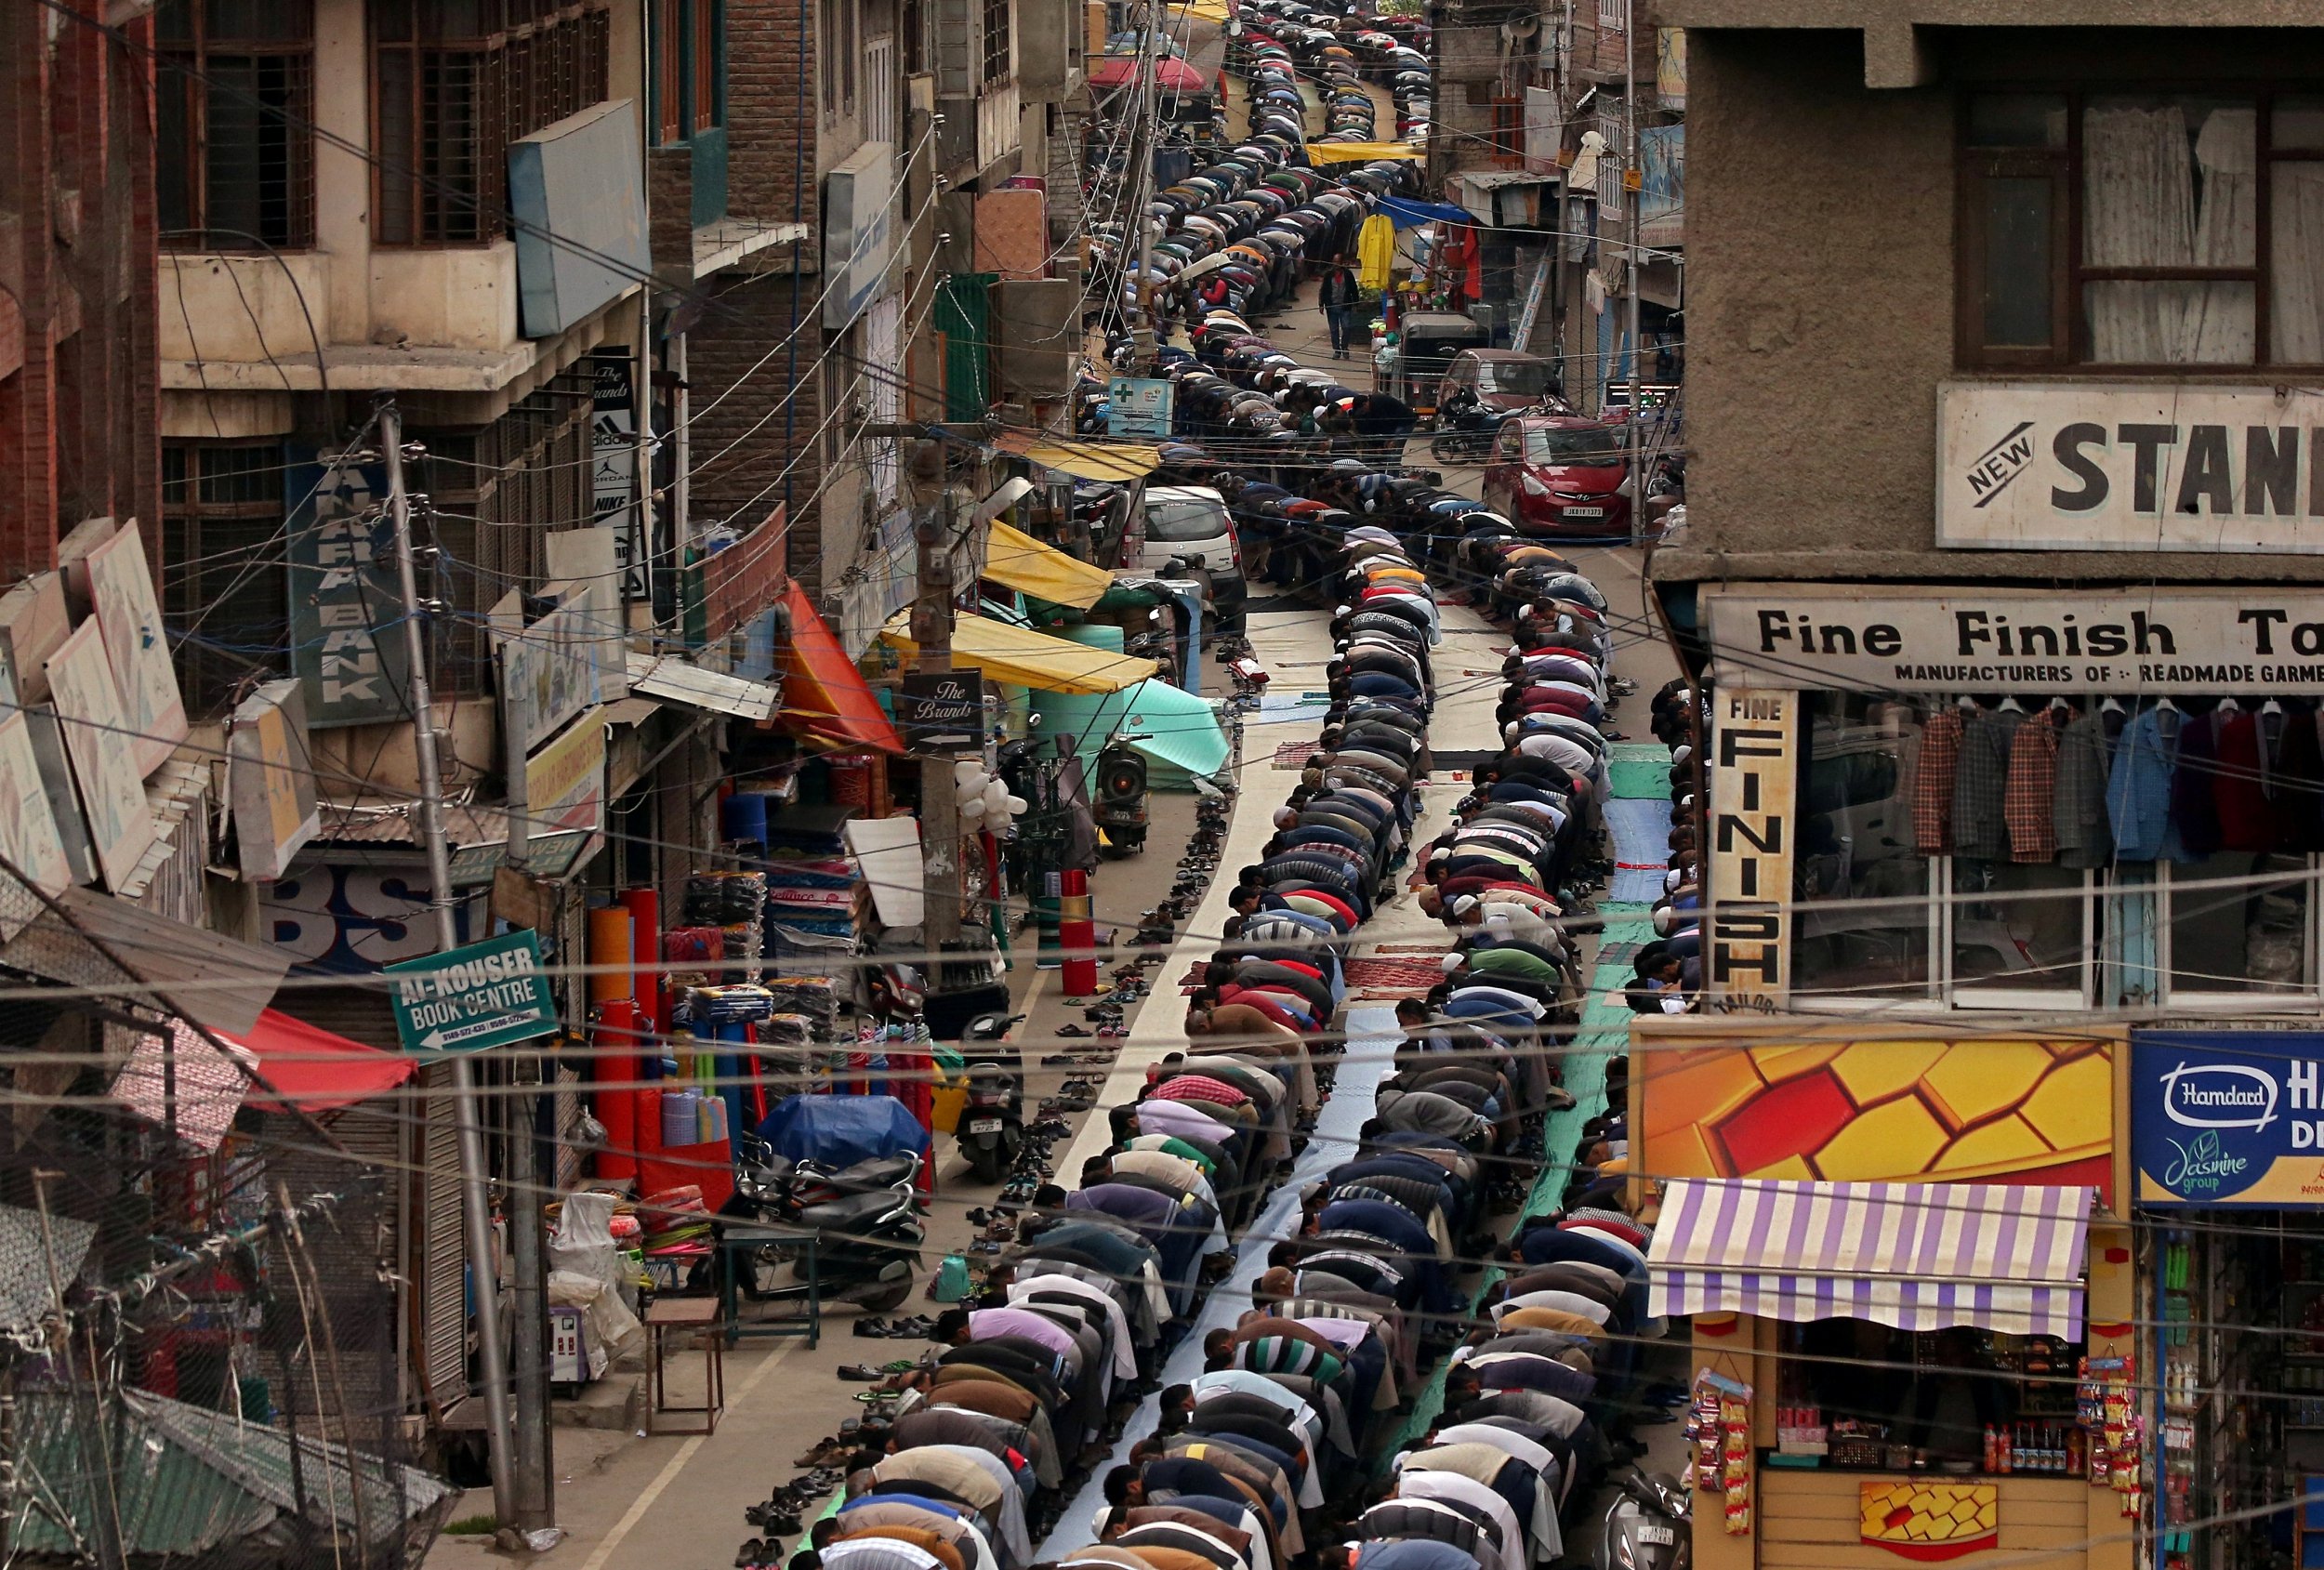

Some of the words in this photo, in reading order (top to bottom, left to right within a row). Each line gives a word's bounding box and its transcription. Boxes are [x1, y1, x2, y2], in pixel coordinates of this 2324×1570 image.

[594, 383, 627, 399] rands
[1966, 437, 2031, 495] NEW
[595, 495, 627, 511] NIKE
[1758, 610, 1902, 657] Fine
[1955, 610, 2177, 656] Finish
[319, 603, 380, 703] BANK
[934, 680, 966, 700] The
[1895, 665, 2073, 682] MANUFACTURERS
[2085, 666, 2111, 682] OF
[2140, 664, 2254, 682] READMADE
[914, 700, 971, 719] Brands
[1731, 699, 1781, 720] FINE
[1713, 729, 1783, 983] FINISH
[410, 996, 463, 1031] BOOK
[465, 978, 537, 1017] CENTRE
[2181, 1083, 2266, 1106] Hamdard
[2287, 1059, 2324, 1109] H
[2165, 1137, 2248, 1186] Jasmine
[2184, 1177, 2219, 1194] group
